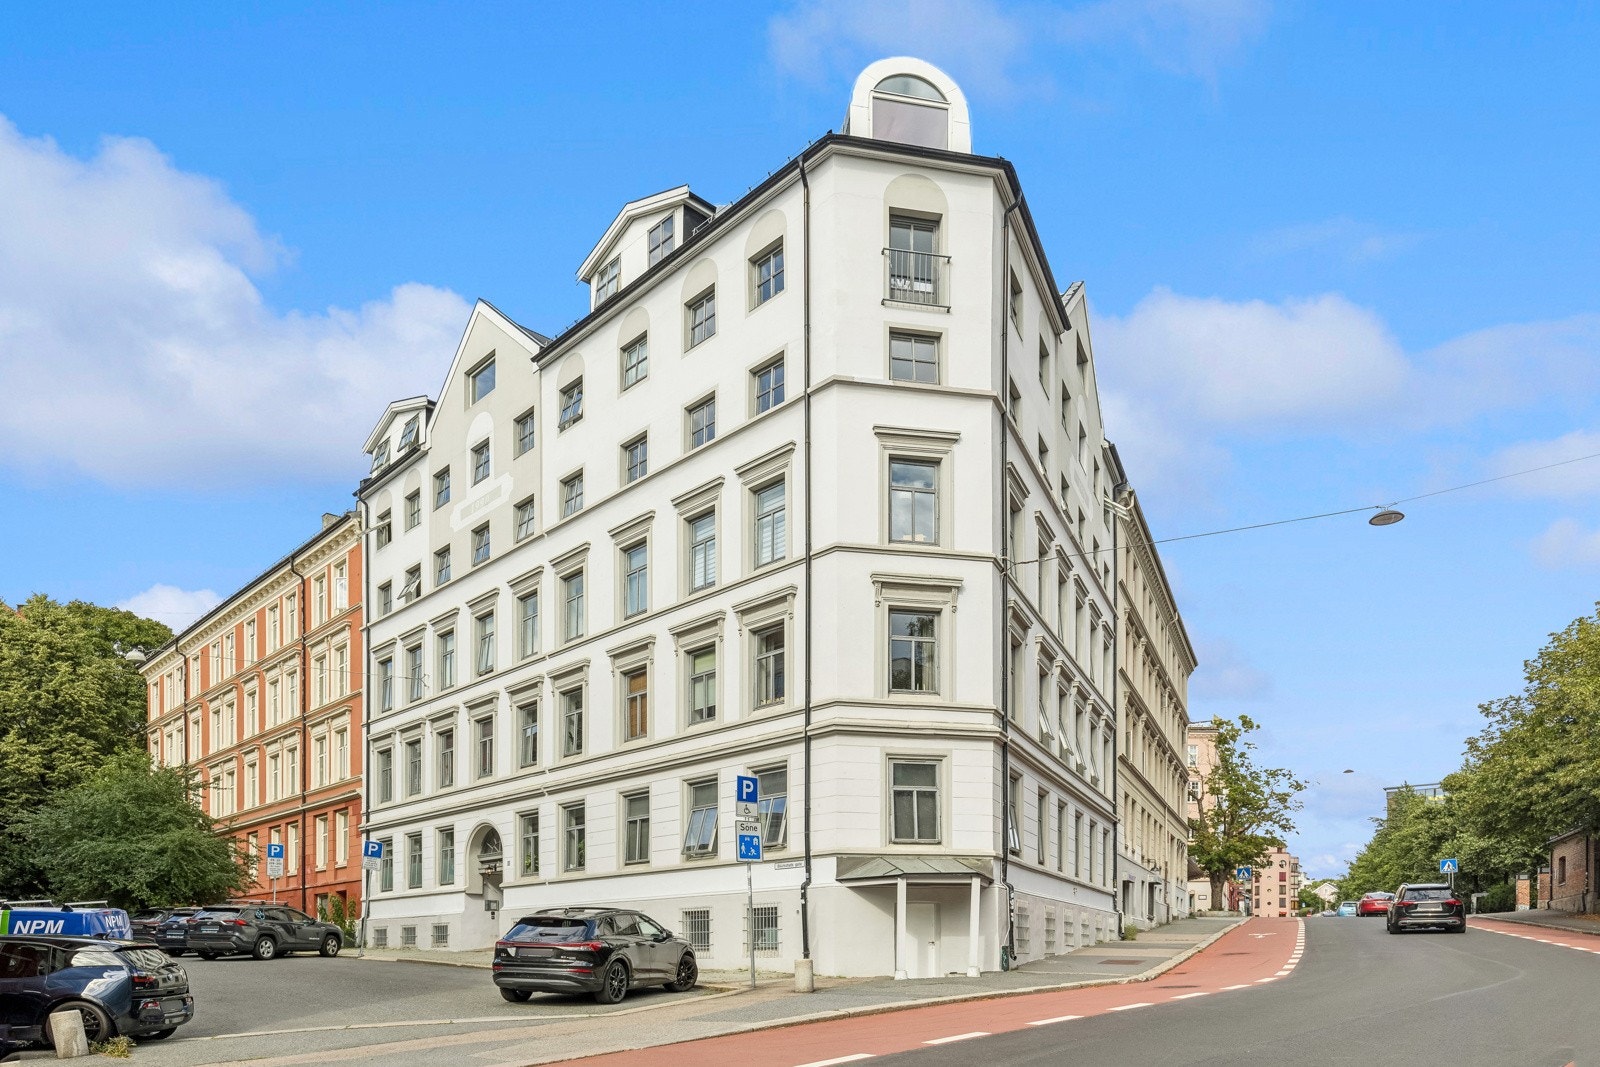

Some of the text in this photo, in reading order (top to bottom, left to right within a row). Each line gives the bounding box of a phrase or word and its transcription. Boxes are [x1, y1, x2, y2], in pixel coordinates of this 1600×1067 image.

[742, 779, 754, 800] P
[740, 823, 758, 832] Sone
[271, 845, 281, 857] P
[368, 842, 379, 856] P
[13, 920, 65, 935] NPM
[104, 915, 123, 928] NPM
